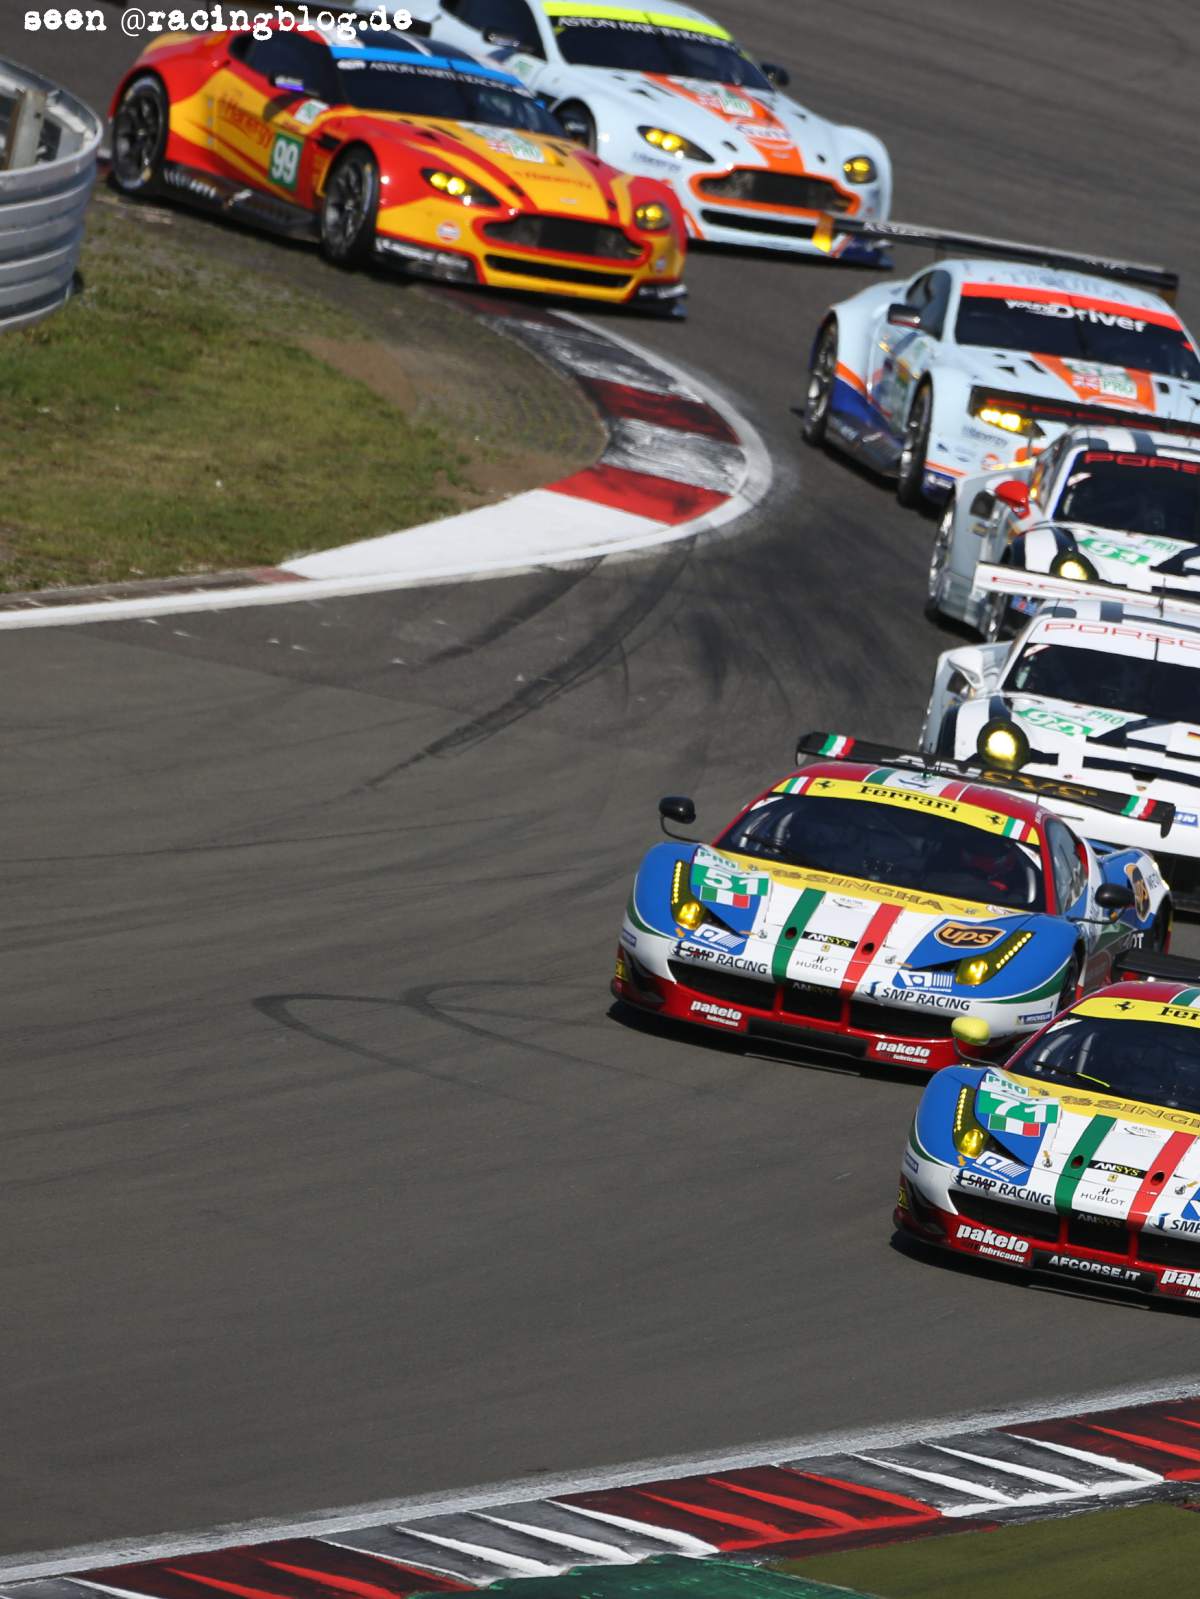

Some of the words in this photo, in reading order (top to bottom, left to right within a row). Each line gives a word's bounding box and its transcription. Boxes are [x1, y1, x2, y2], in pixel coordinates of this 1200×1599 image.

[272, 137, 299, 184] 99
[858, 784, 960, 814] Ferrari
[698, 849, 737, 869] PRO
[703, 869, 758, 895] 51
[797, 873, 945, 912] SINGHA
[807, 933, 851, 948] ANSYS
[685, 946, 715, 962] SMP
[716, 953, 769, 975] RACING
[795, 960, 839, 974] HUBLOT
[690, 999, 743, 1021] pakelo
[881, 987, 915, 1003] SMP
[915, 992, 971, 1012] RACING
[875, 1040, 931, 1058] pakelo
[987, 1075, 1027, 1096] PRO
[989, 1093, 1047, 1123] 71
[1093, 1162, 1141, 1177] ANSYS
[968, 1174, 997, 1191] SMP
[1000, 1179, 1052, 1207] RACING
[1080, 1192, 1126, 1207] HUBLOT
[956, 1223, 1030, 1253] pakelo
[978, 1245, 1025, 1263] lubricants
[1048, 1254, 1142, 1282] AFCORSE.IT
